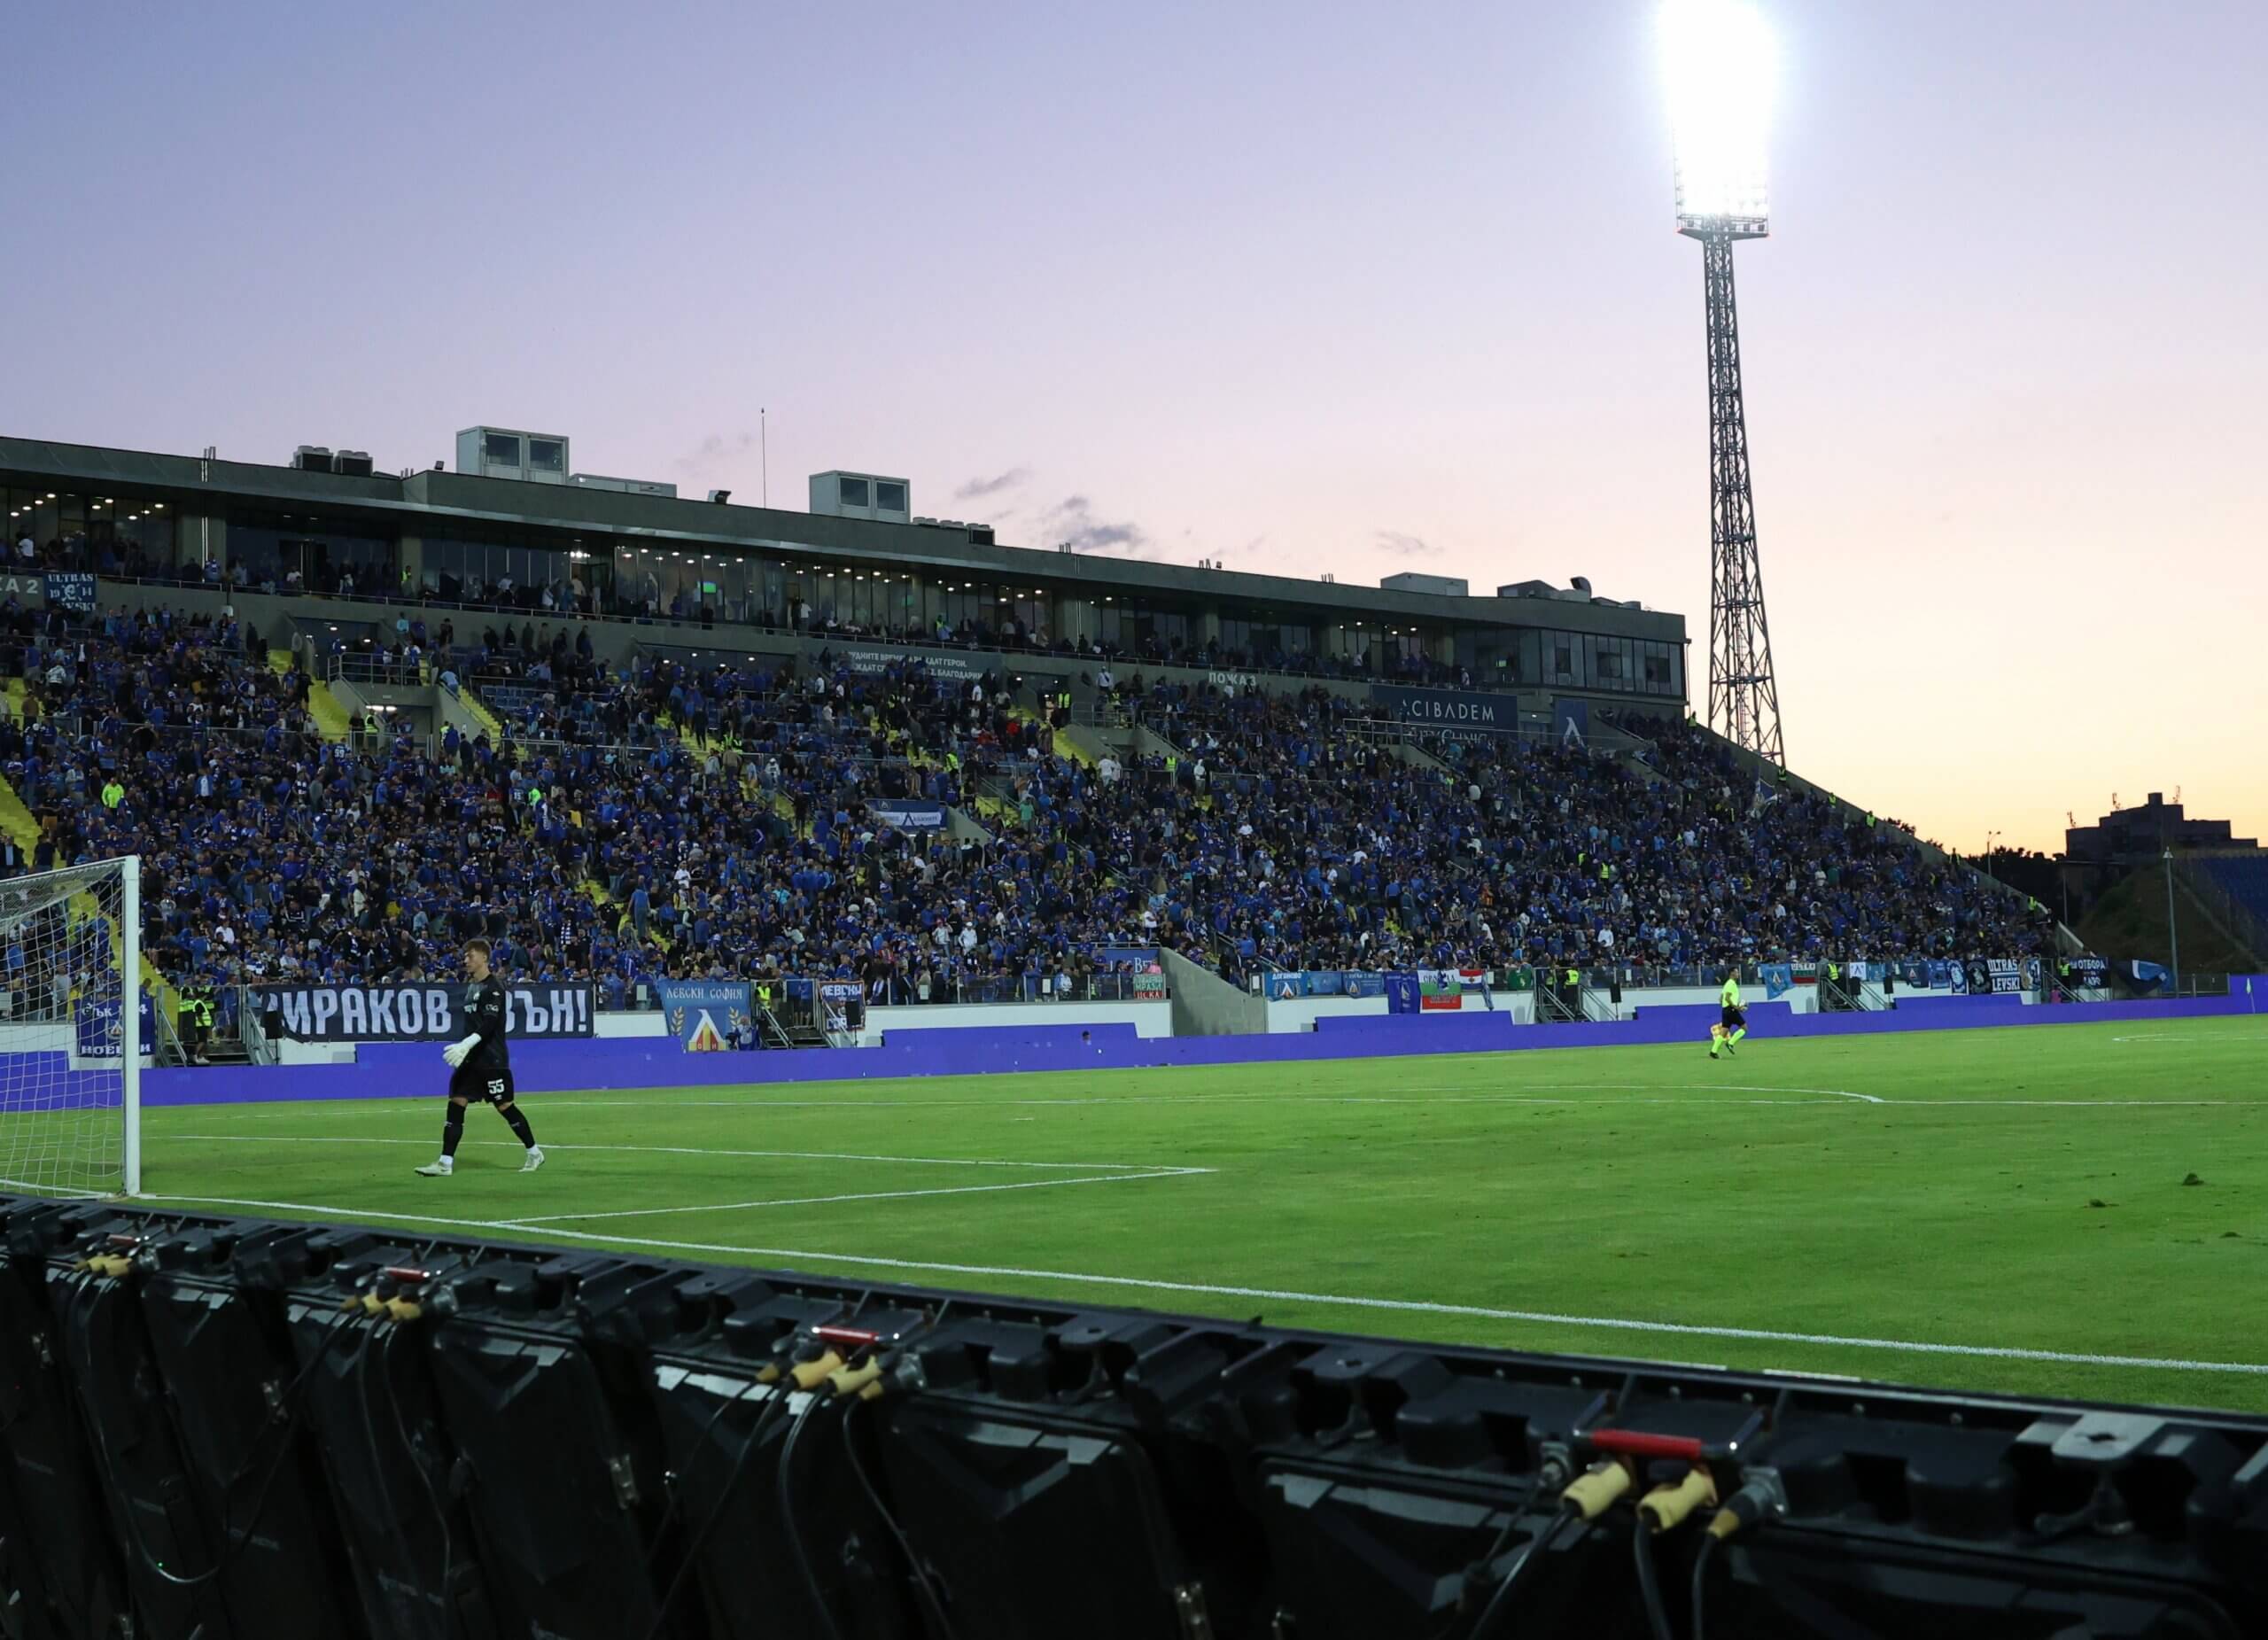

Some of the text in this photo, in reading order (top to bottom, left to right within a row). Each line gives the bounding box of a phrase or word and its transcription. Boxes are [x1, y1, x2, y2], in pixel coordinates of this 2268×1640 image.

[48, 573, 94, 583] ULTRAS
[27, 579, 38, 594] 2
[50, 588, 60, 599] 19
[1986, 959, 2017, 972] ULTRAS
[1992, 977, 2020, 991] LEVSKI
[666, 987, 742, 1000] ЛЕВСКИ СОФИЯ
[486, 1077, 505, 1094] 55
